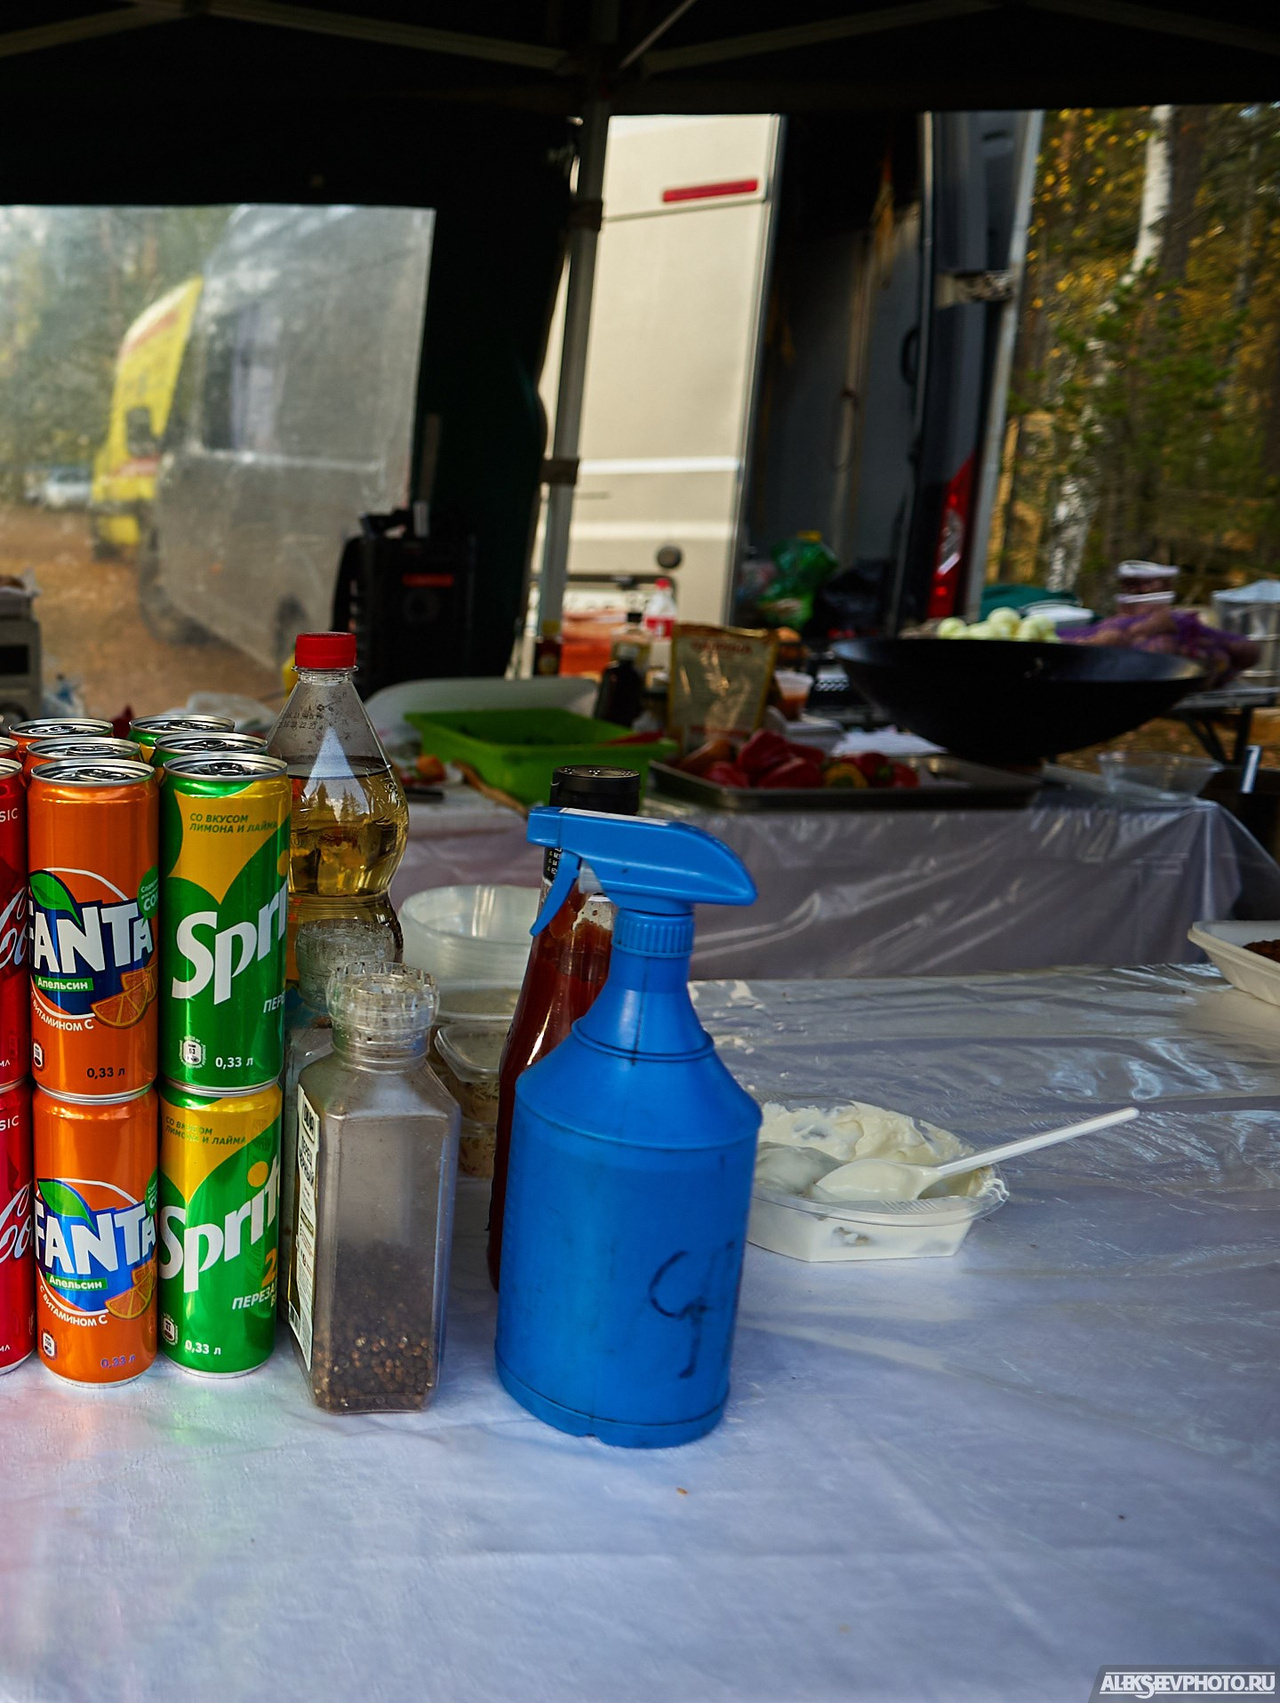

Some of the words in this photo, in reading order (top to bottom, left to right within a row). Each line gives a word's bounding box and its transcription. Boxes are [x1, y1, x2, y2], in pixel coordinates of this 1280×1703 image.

[189, 812, 204, 823] СО
[205, 813, 249, 823] ВКУСОМ
[189, 823, 234, 833] ЛИМОНА
[237, 824, 244, 832] И
[247, 821, 277, 832] ЛАЙМА
[37, 977, 88, 990] Апельсин
[84, 1019, 94, 1029] С
[215, 1057, 242, 1070] 0,33
[245, 1057, 254, 1066] л
[86, 1067, 114, 1080] 0,33
[117, 1067, 125, 1077] л
[202, 1136, 209, 1144] И
[211, 1135, 247, 1145] ЛАЙМА
[34, 1198, 156, 1275] FANTA
[49, 1275, 103, 1290] Апельсин
[42, 1293, 97, 1327] ВИТАМИНОМ
[98, 1314, 108, 1325] С
[184, 1340, 210, 1355] 0,33
[213, 1346, 221, 1356] л
[100, 1355, 126, 1369] 0,33
[128, 1354, 136, 1363] л
